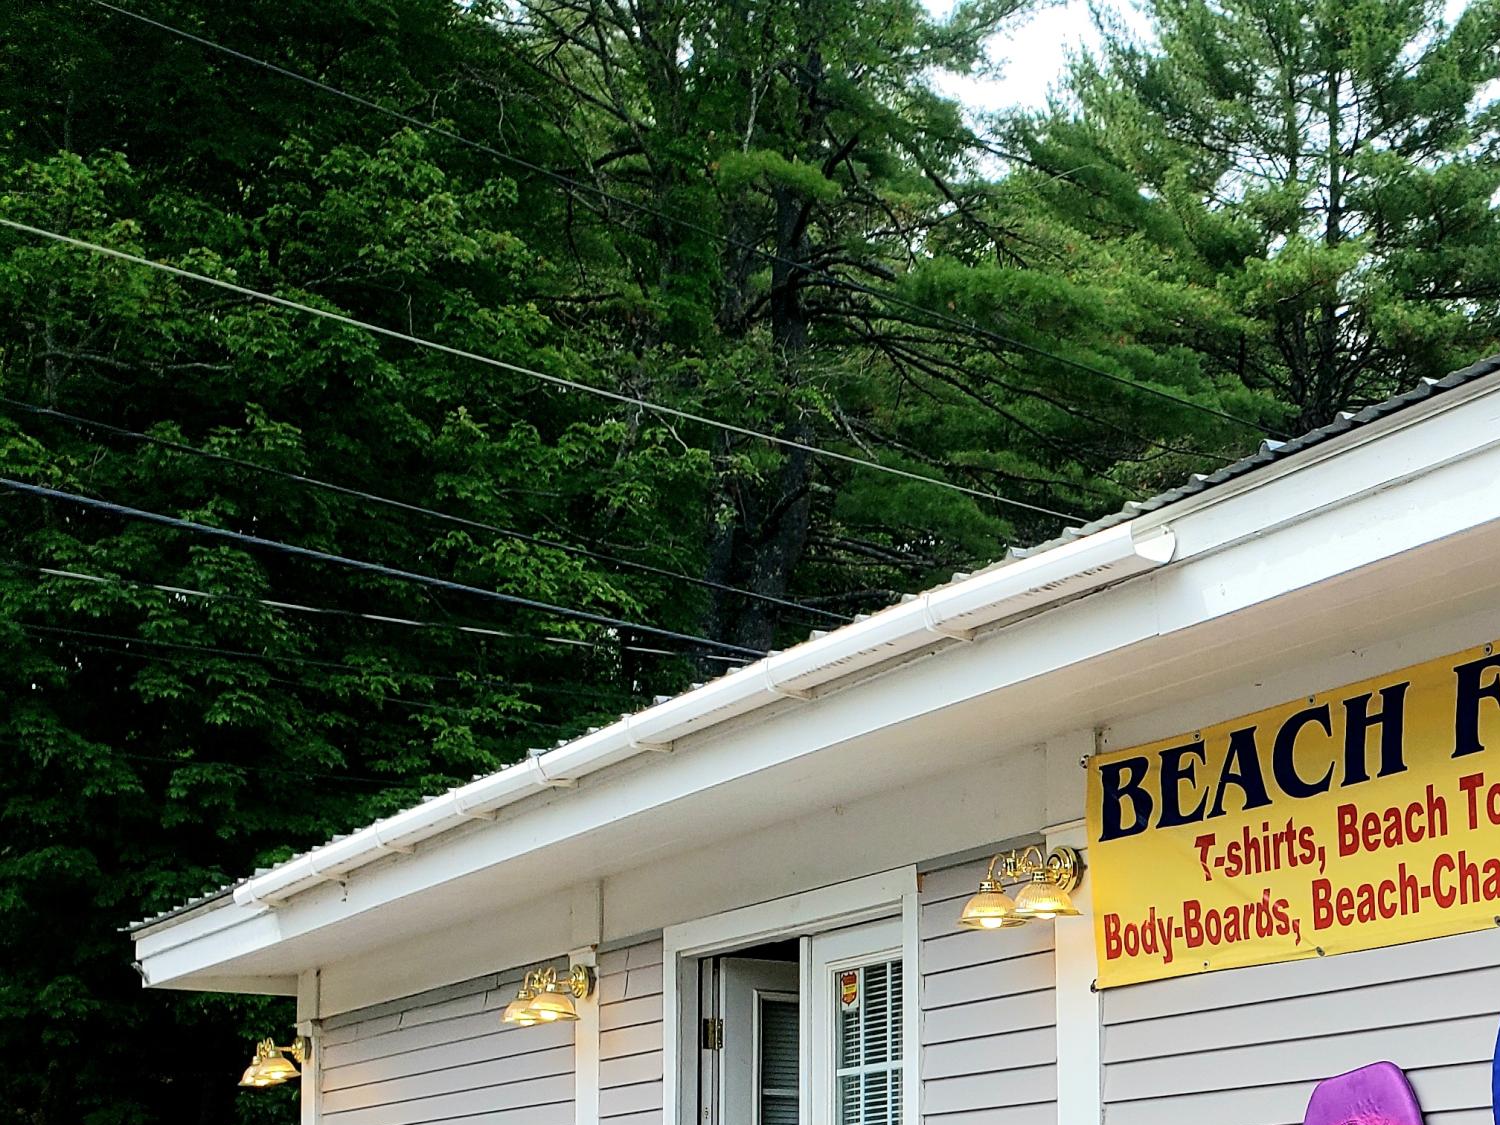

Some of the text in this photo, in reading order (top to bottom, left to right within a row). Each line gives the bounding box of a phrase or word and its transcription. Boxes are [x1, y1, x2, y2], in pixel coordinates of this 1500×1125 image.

[1097, 681, 1411, 843] BEACH
[1194, 816, 1327, 883] T-shirts,
[1337, 785, 1449, 858] Beach
[1103, 890, 1302, 964] Body-Boards,
